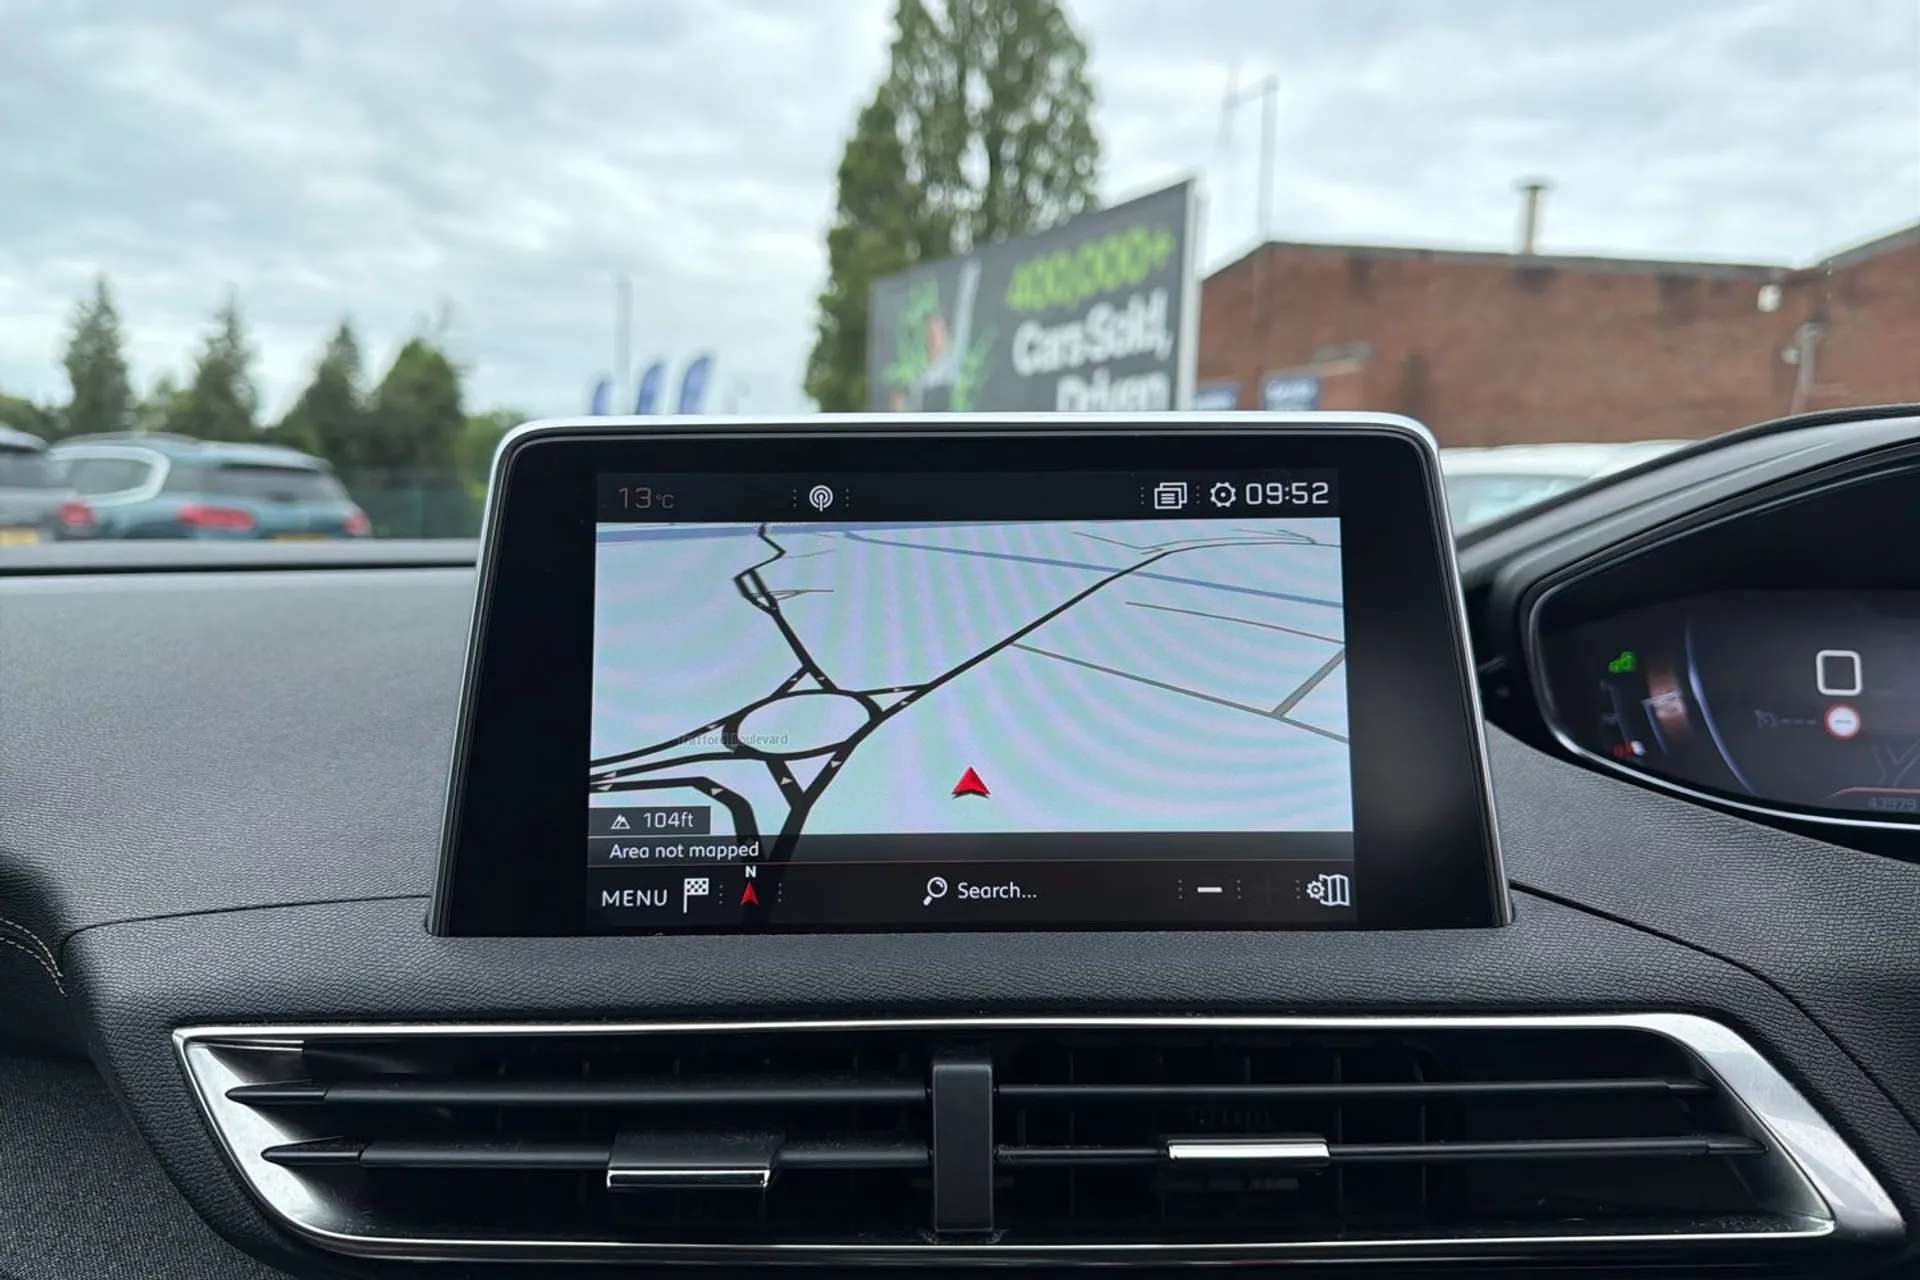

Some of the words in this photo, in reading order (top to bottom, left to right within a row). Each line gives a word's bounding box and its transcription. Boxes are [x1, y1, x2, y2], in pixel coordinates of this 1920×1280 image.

[1012, 320, 1087, 377] Cars
[1246, 482, 1329, 505] 09:52
[643, 812, 694, 829] 104ft
[609, 844, 650, 859] Area
[655, 844, 684, 858] not
[689, 841, 760, 860] mapped
[745, 865, 757, 878] N
[602, 889, 668, 908] MENU
[957, 881, 1038, 899] Search...
